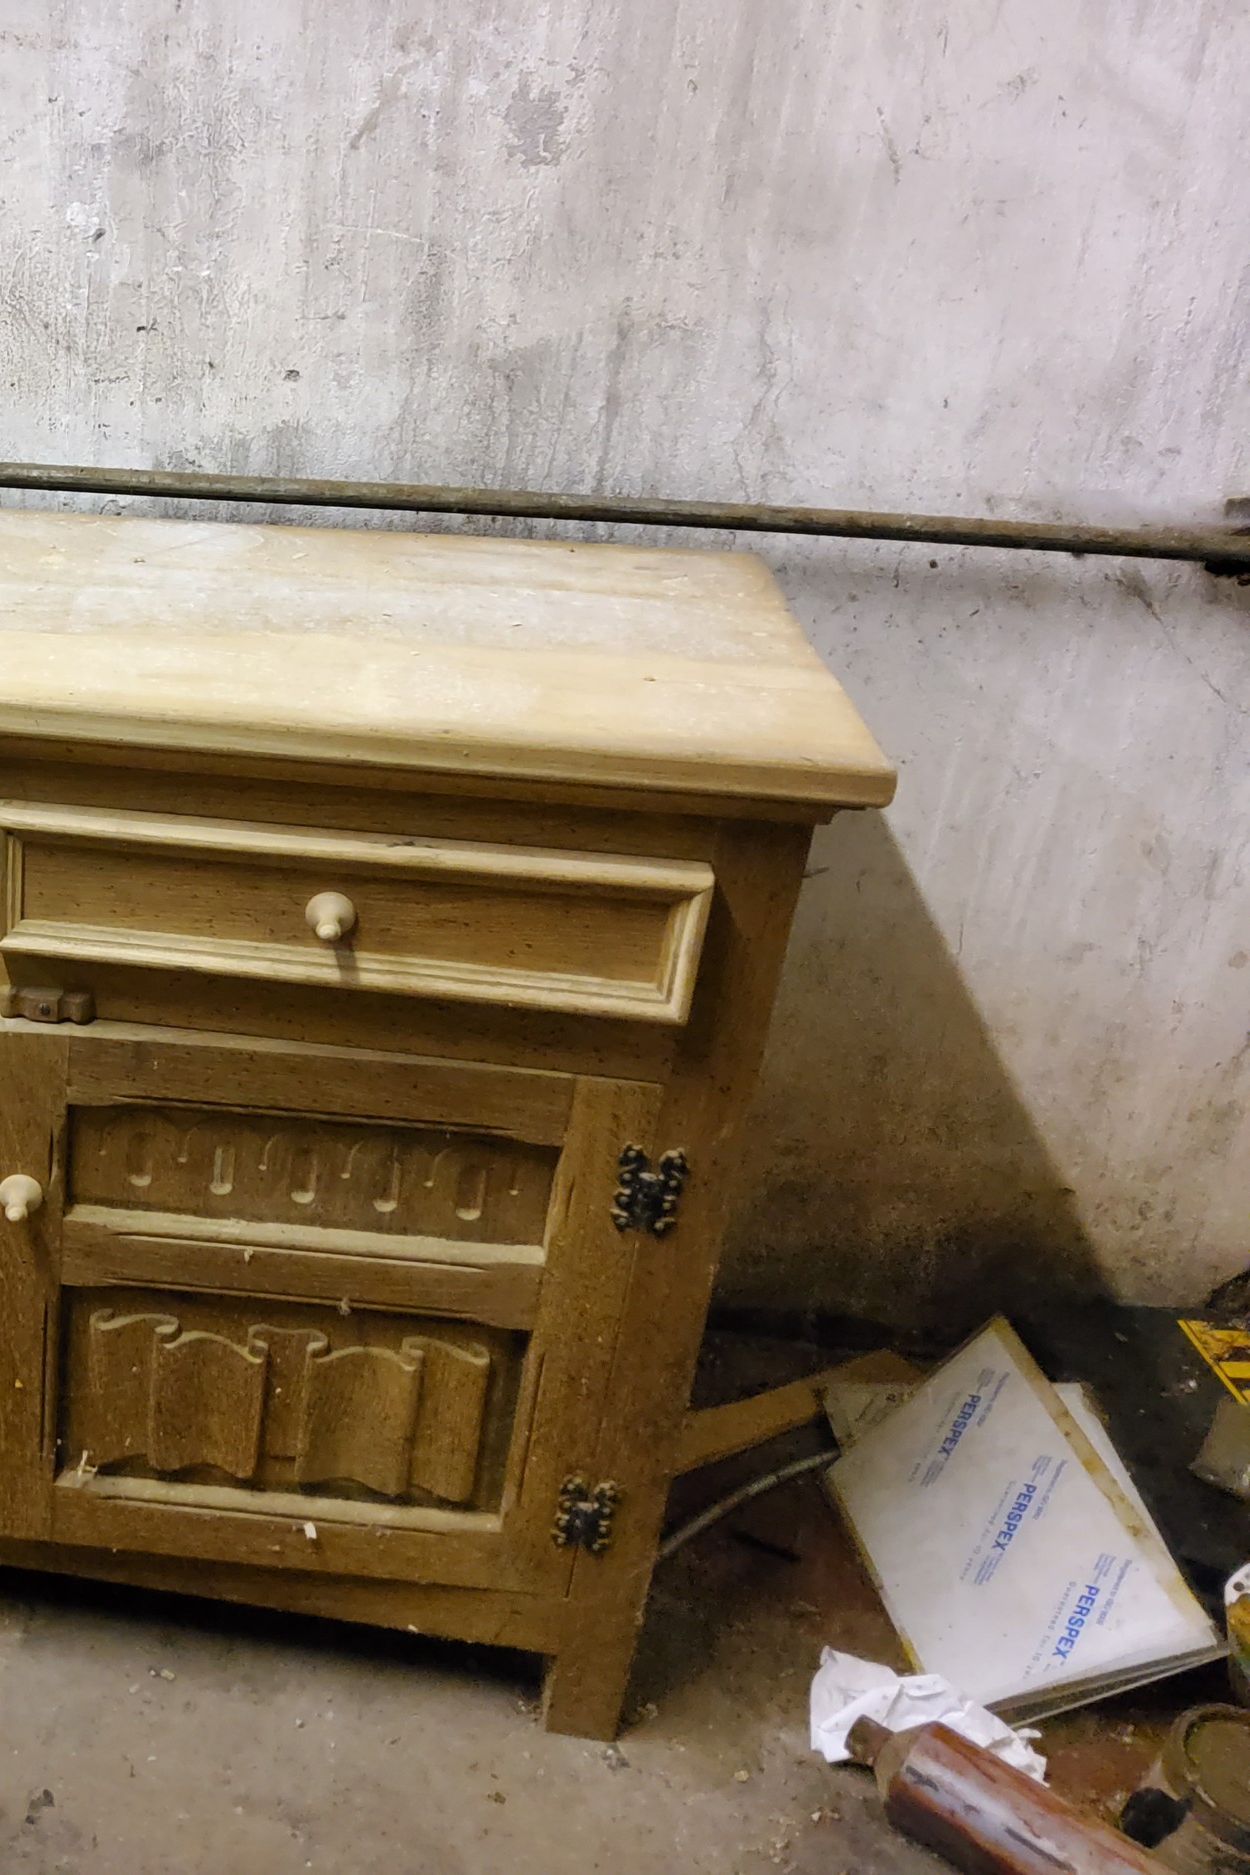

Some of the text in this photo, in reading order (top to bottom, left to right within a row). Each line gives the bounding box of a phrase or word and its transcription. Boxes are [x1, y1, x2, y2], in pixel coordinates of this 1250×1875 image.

[938, 1393, 981, 1459] PERSPEX
[992, 1483, 1037, 1552] PERSPEX
[1051, 1585, 1100, 1661] PERSPEX
